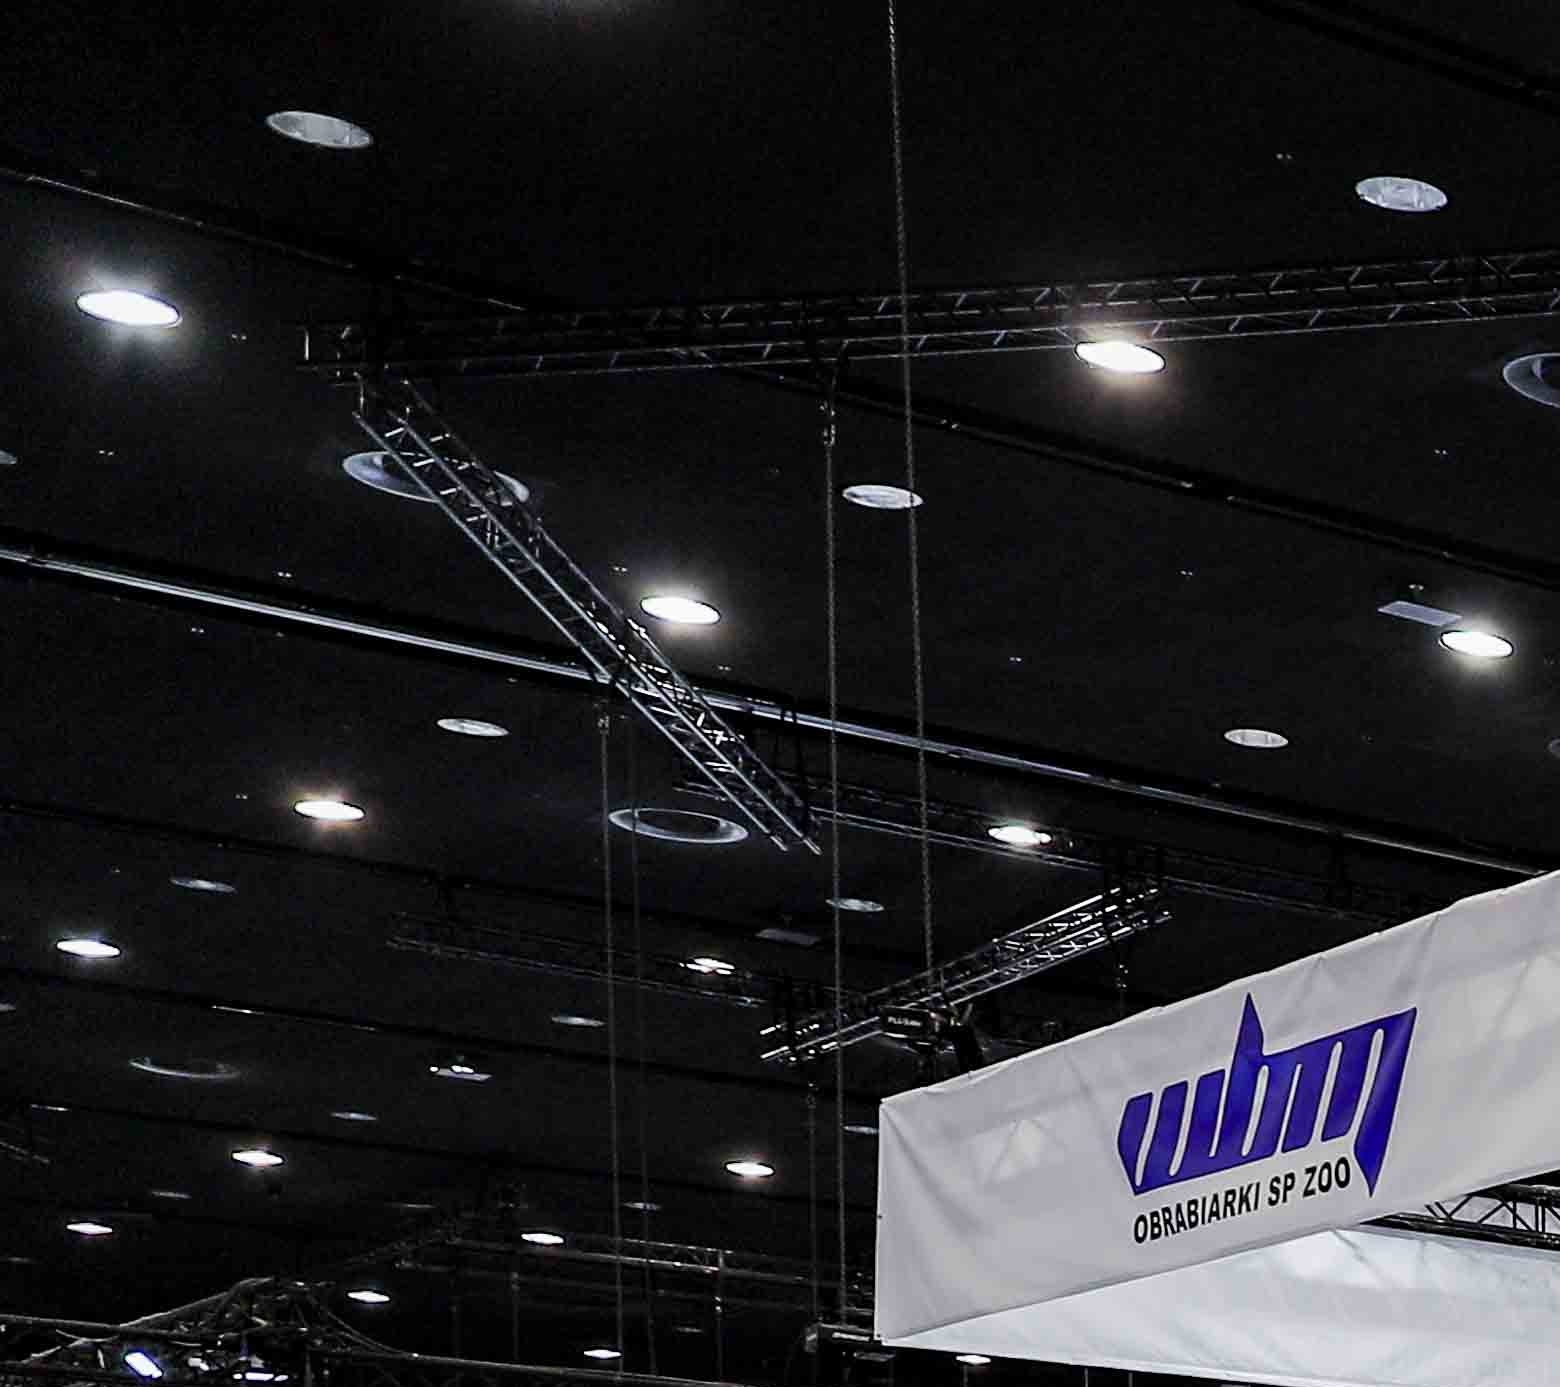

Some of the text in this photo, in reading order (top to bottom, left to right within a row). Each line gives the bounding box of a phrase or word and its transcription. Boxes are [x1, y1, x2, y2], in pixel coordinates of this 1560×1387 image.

[1132, 1158, 1352, 1245] OBRABIARKI SP ZOO
